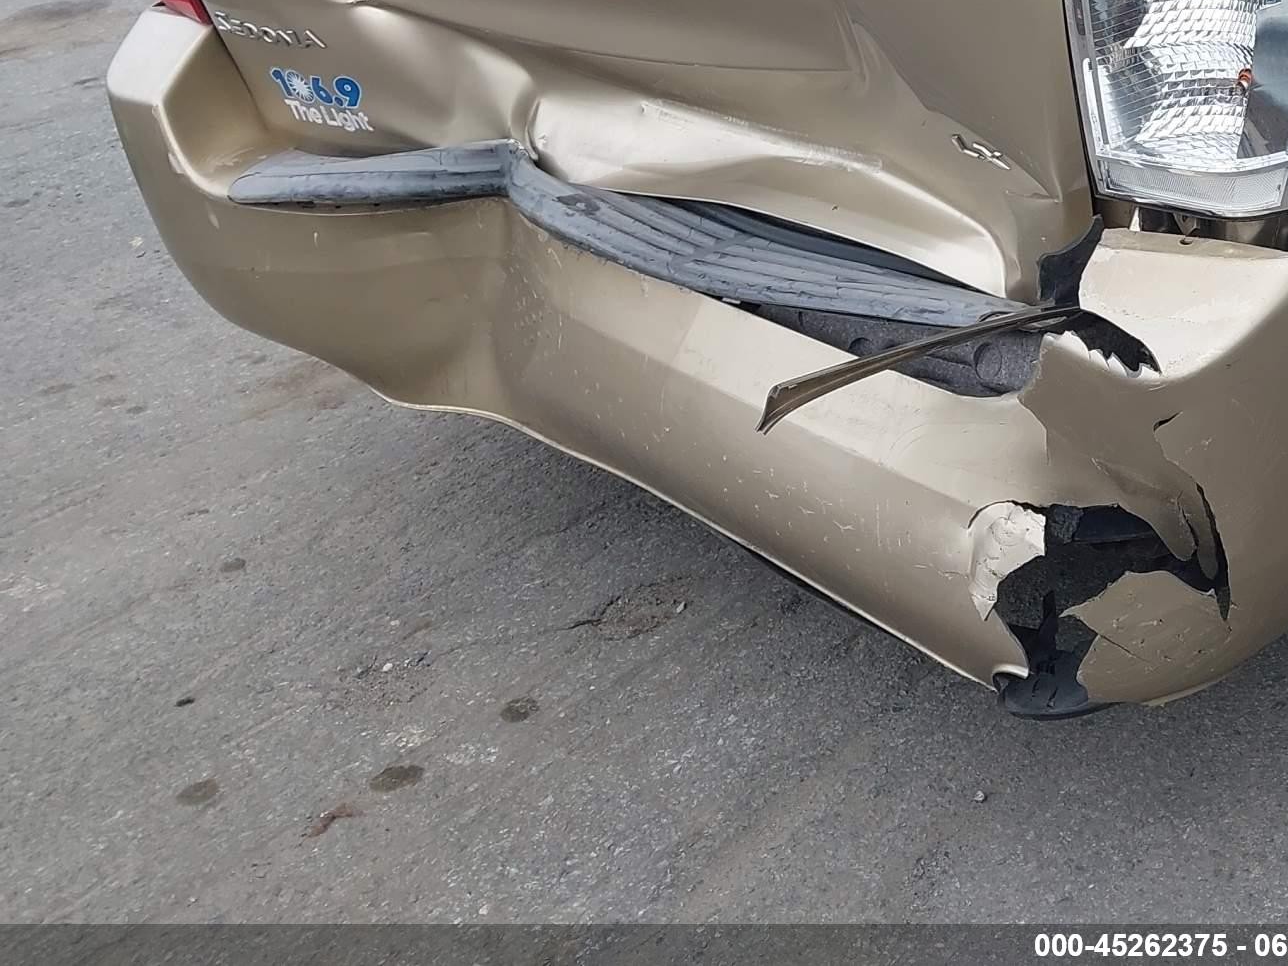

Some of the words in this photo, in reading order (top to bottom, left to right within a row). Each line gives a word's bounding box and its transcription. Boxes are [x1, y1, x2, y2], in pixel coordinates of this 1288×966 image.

[215, 11, 327, 49] SEDONA
[284, 98, 323, 121] The
[320, 105, 375, 132] Light
